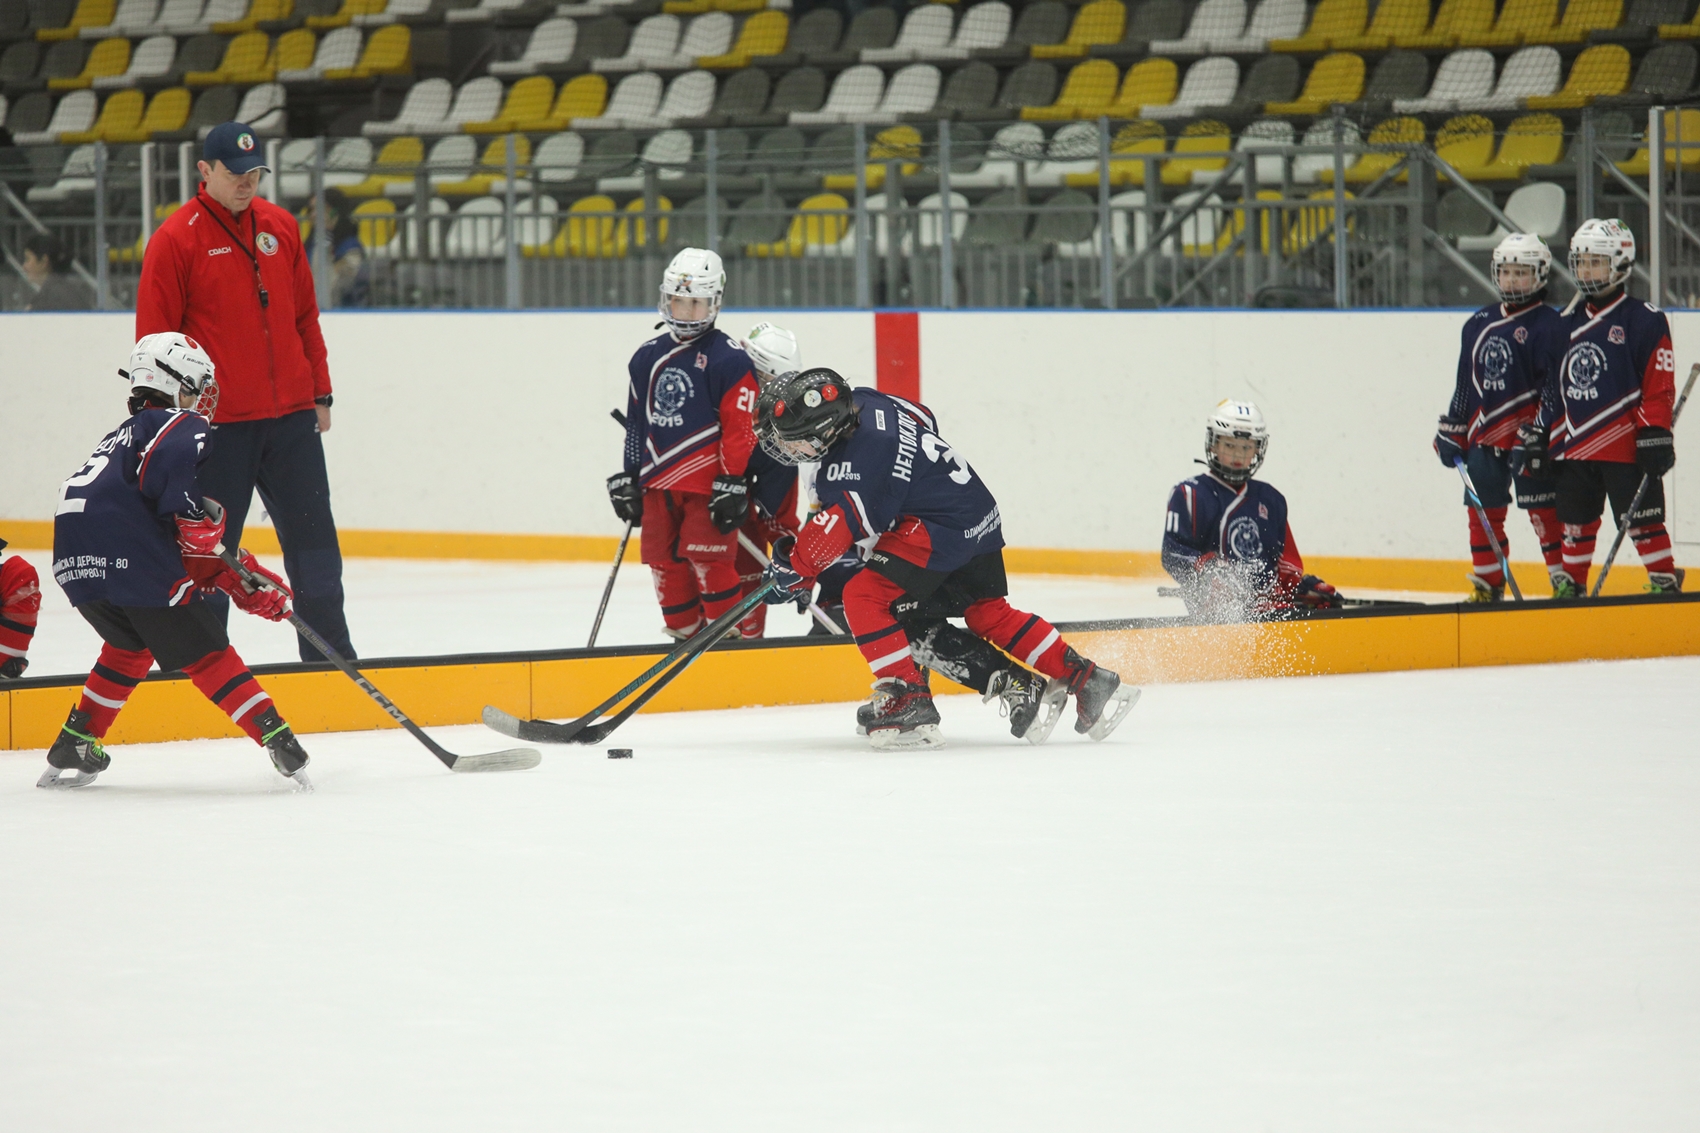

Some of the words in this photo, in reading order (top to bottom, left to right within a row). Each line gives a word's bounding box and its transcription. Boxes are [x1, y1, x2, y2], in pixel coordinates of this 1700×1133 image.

[208, 246, 232, 256] COACH
[1483, 379, 1506, 391] 015
[1566, 385, 1599, 401] 2015
[736, 386, 756, 413] 21
[1238, 406, 1249, 415] 11
[652, 411, 684, 428] 2015
[826, 462, 852, 481] ОД
[844, 473, 861, 481] 2015
[813, 510, 839, 535] 31
[1166, 510, 1180, 532] 11
[686, 543, 728, 553] BAUER
[115, 558, 128, 569] 80
[616, 652, 675, 701] BAUER
[355, 677, 408, 723] CCM
